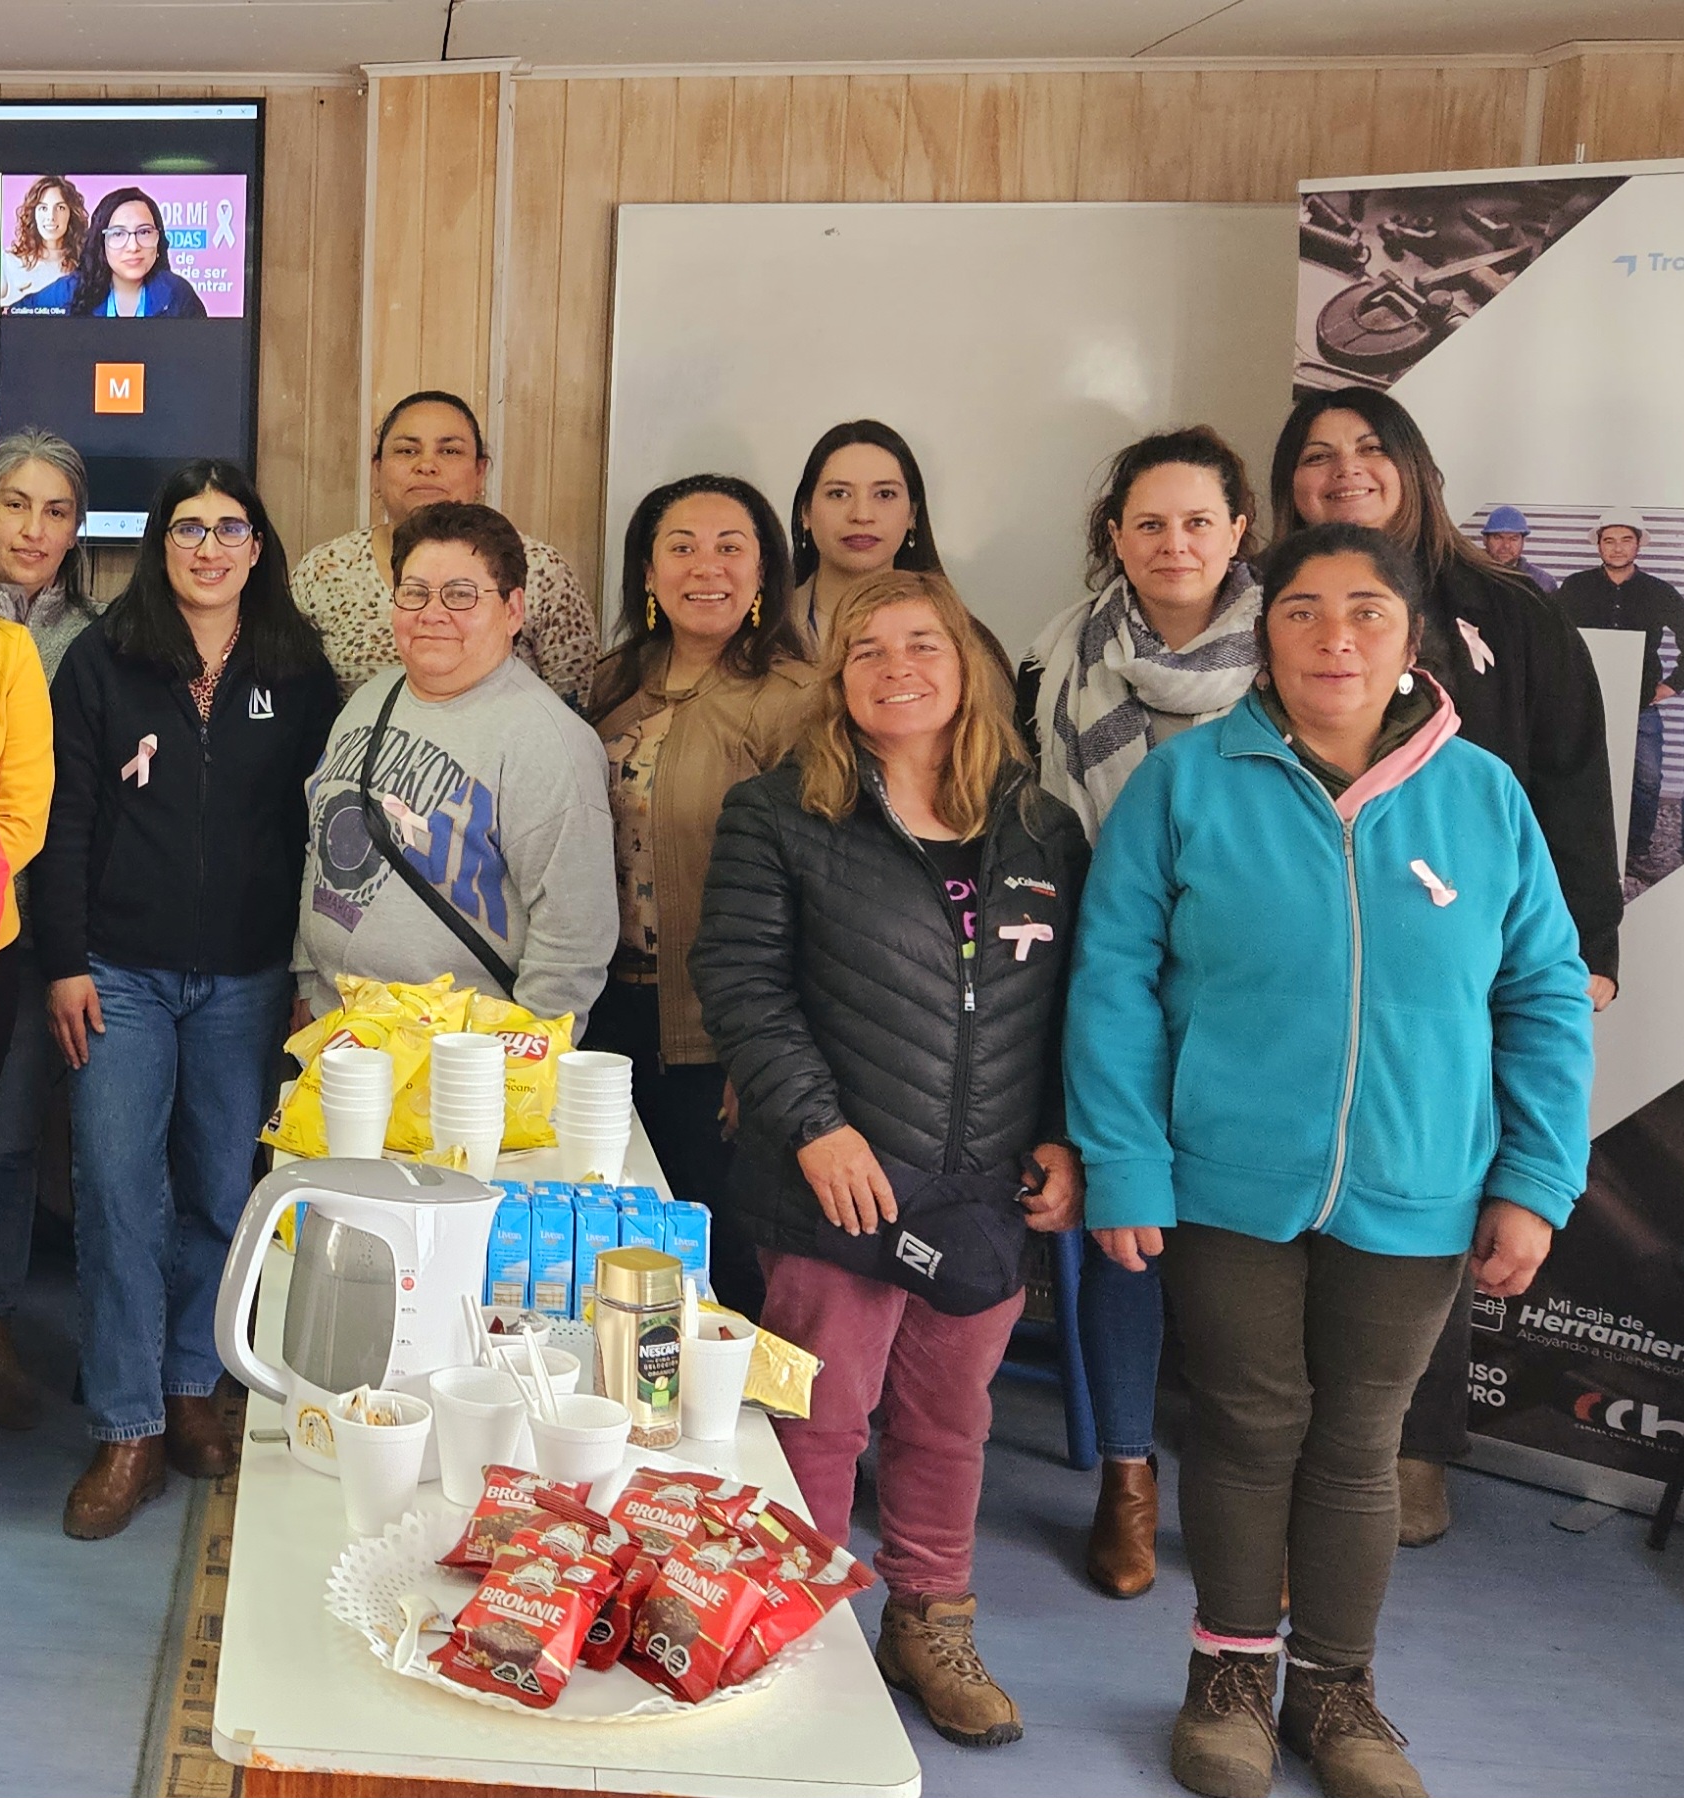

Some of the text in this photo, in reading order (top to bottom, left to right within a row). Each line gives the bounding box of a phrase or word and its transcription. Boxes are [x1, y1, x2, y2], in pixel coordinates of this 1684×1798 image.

[176, 252, 195, 265] de
[204, 268, 227, 279] ser
[109, 377, 130, 400] M
[1548, 1297, 1644, 1332] Mi caja de
[1516, 1328, 1588, 1354] Apoyando
[625, 1501, 698, 1533] BROWNI
[663, 1557, 729, 1608] BROWNIE
[478, 1586, 566, 1627] BROWNIE
